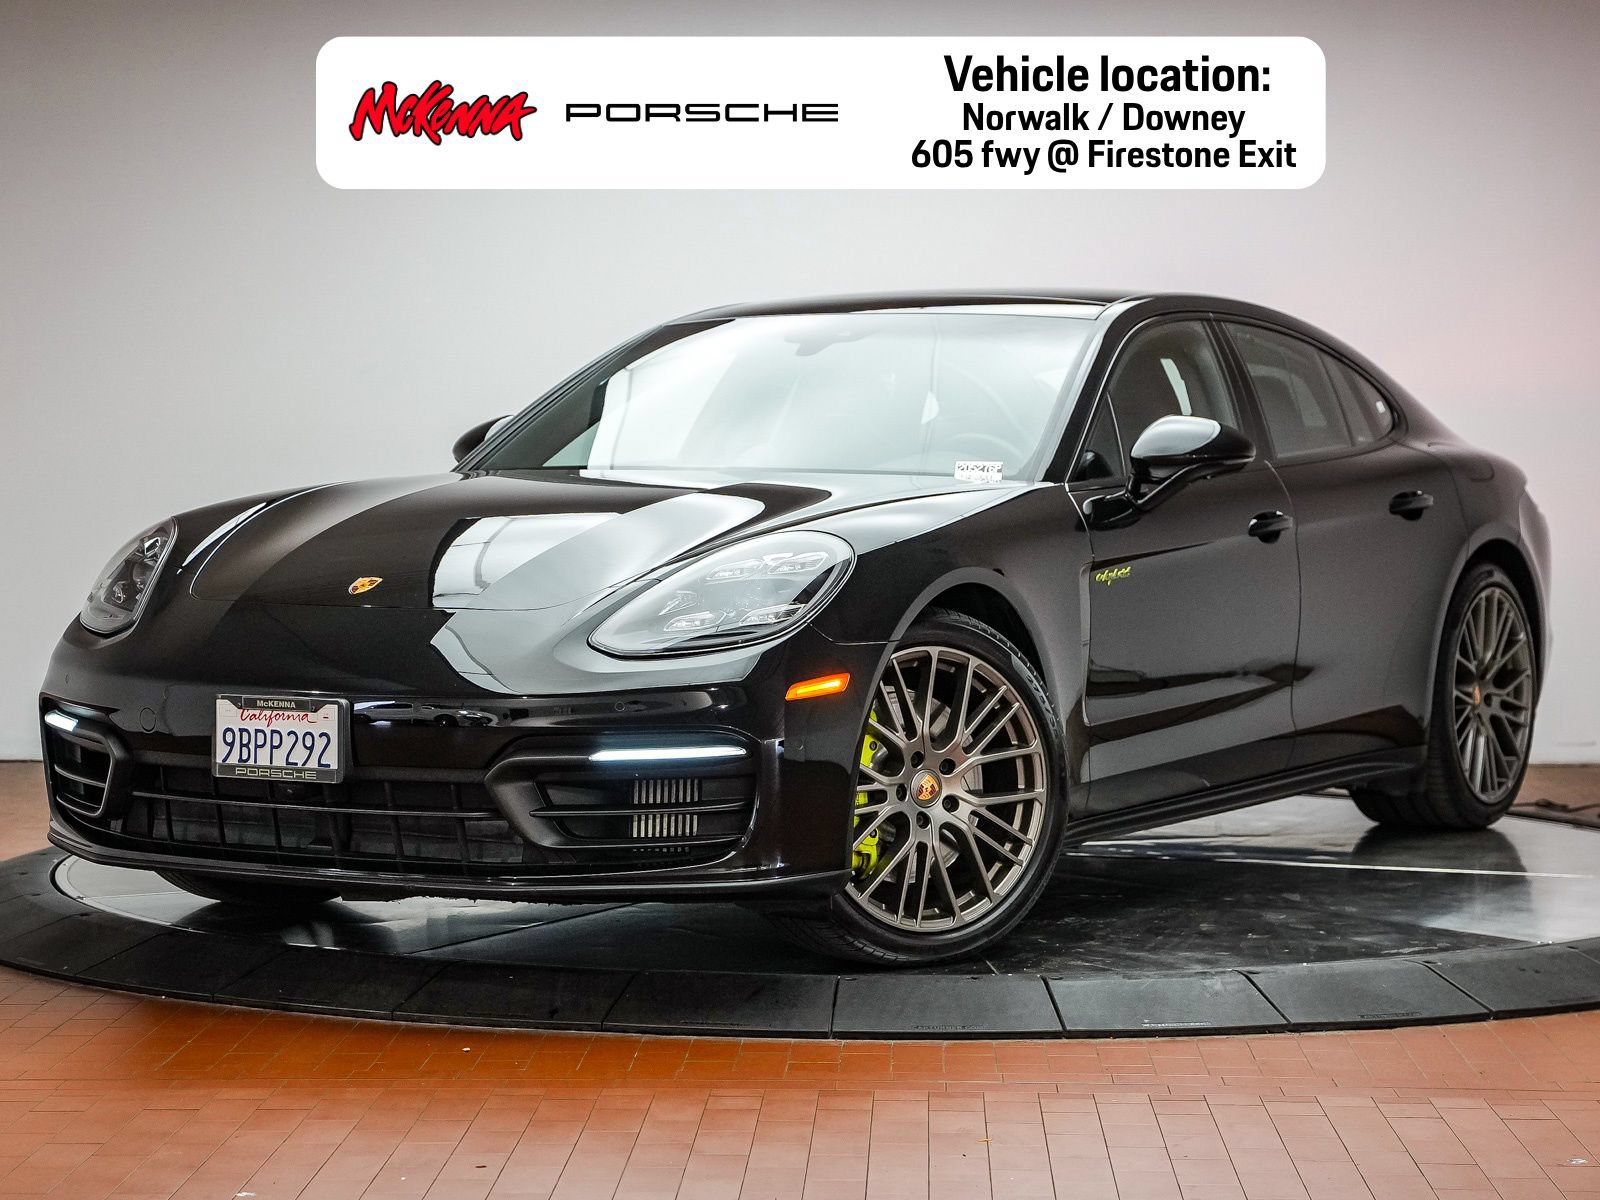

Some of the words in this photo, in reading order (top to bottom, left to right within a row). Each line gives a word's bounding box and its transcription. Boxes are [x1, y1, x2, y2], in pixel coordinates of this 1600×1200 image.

[256, 699, 296, 708] McKENNA
[240, 709, 317, 727] California
[221, 727, 331, 769] 9BPP292
[235, 767, 317, 780] PORSCHE
